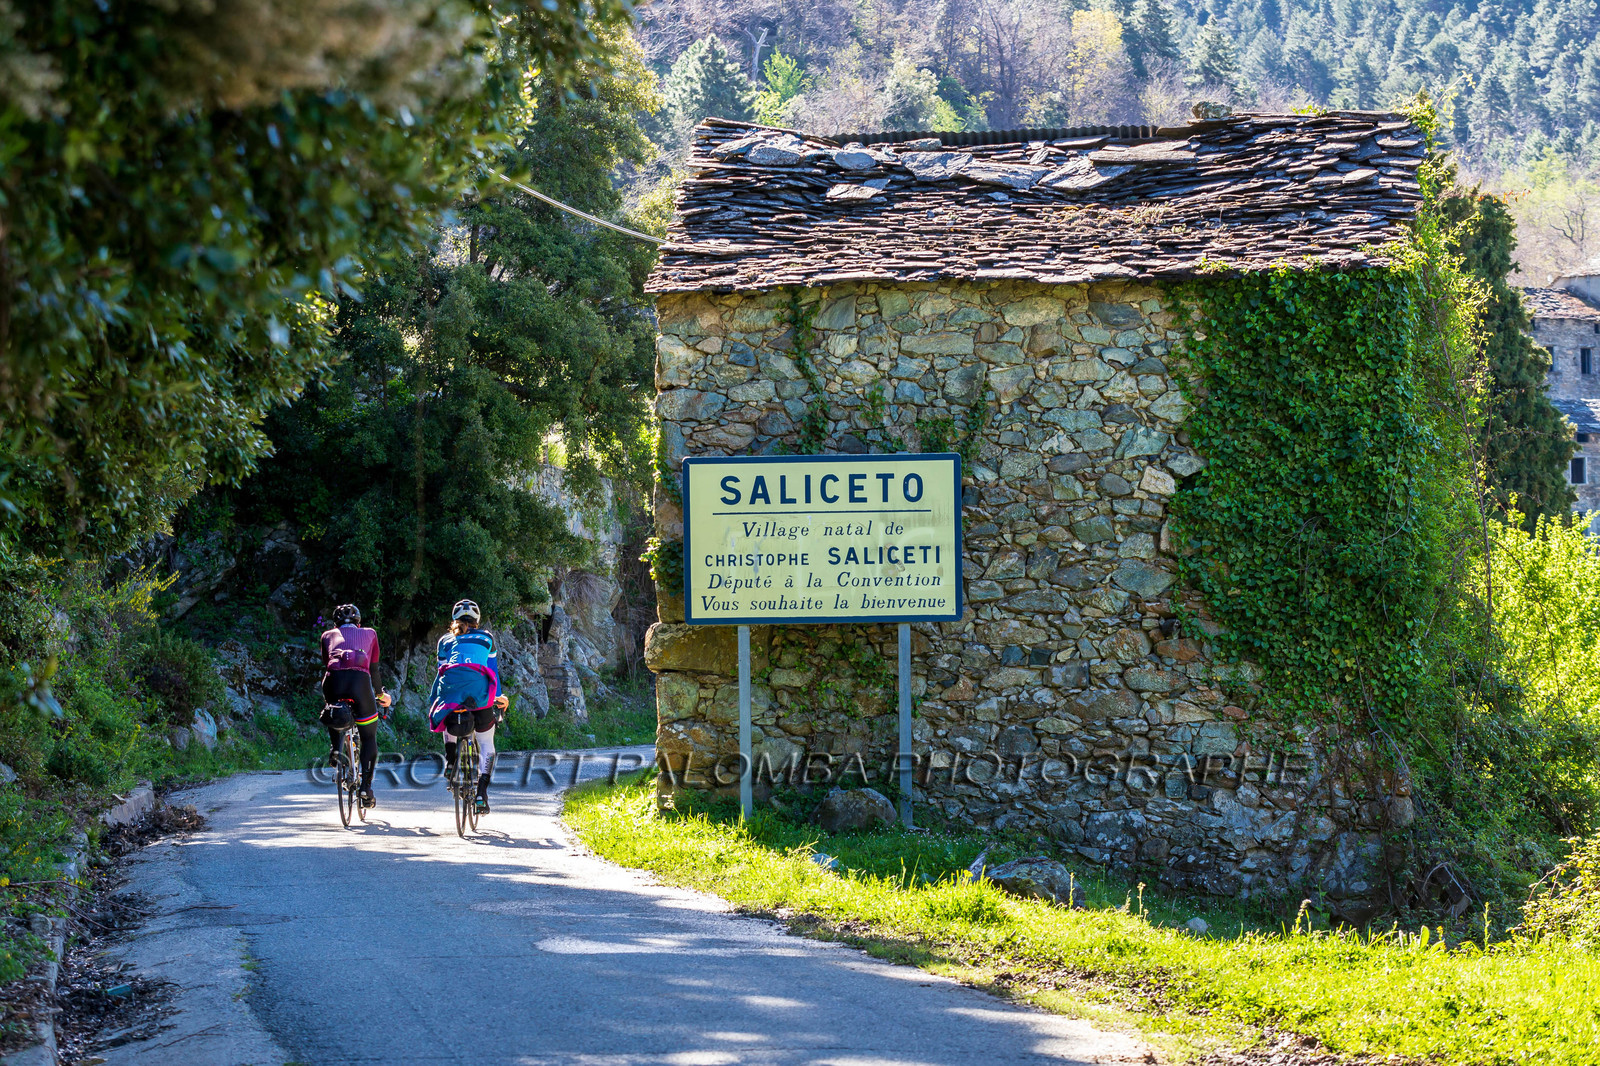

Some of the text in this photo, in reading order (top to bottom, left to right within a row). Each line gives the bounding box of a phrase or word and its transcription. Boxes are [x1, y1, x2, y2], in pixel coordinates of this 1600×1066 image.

[720, 473, 924, 506] SALICETO
[742, 520, 904, 541] Village natal de
[705, 545, 941, 567] CHRISTOPHE SALICETI
[707, 571, 941, 594] Député à la Convention
[701, 593, 946, 612] Vous souhaite la bienvenue
